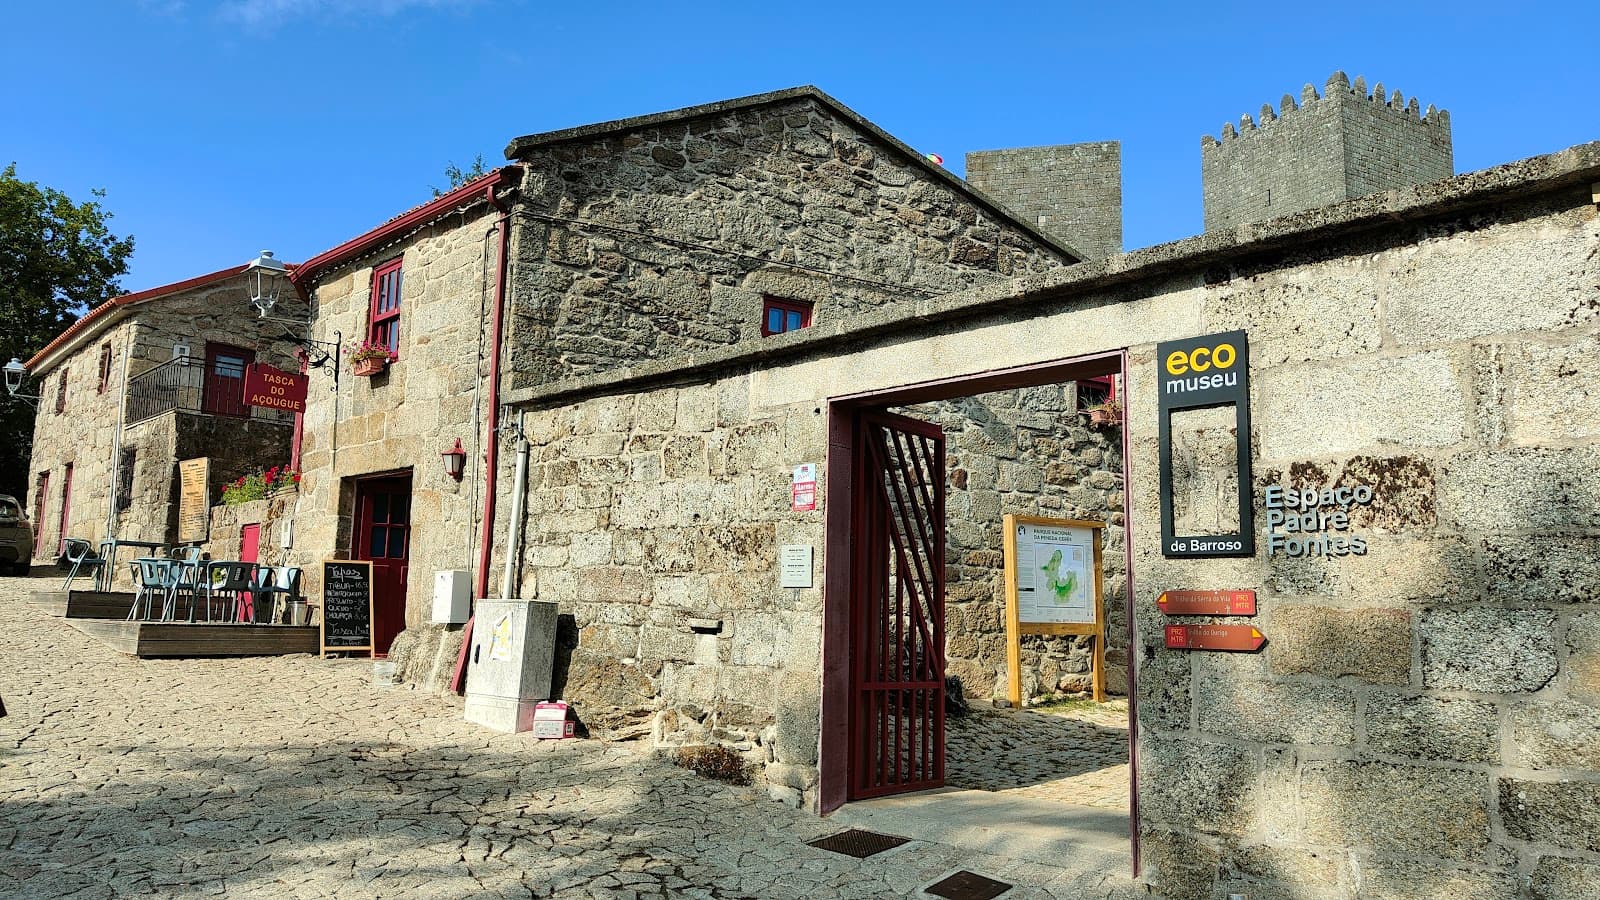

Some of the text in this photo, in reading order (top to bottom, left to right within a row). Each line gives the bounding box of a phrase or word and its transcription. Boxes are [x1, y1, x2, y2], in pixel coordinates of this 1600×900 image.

[1166, 342, 1236, 376] eco
[263, 373, 295, 386] TASCA
[1166, 371, 1237, 394] museu
[270, 386, 285, 396] DO
[251, 394, 301, 410] AÇOUGUE
[794, 482, 815, 492] Alarme
[1265, 484, 1373, 511] Espaço
[1266, 508, 1349, 533] Padre
[1051, 529, 1073, 537] NACIONAL
[1170, 538, 1242, 553] de Barroso
[1267, 531, 1367, 557] Fontes
[327, 565, 361, 582] Tapas
